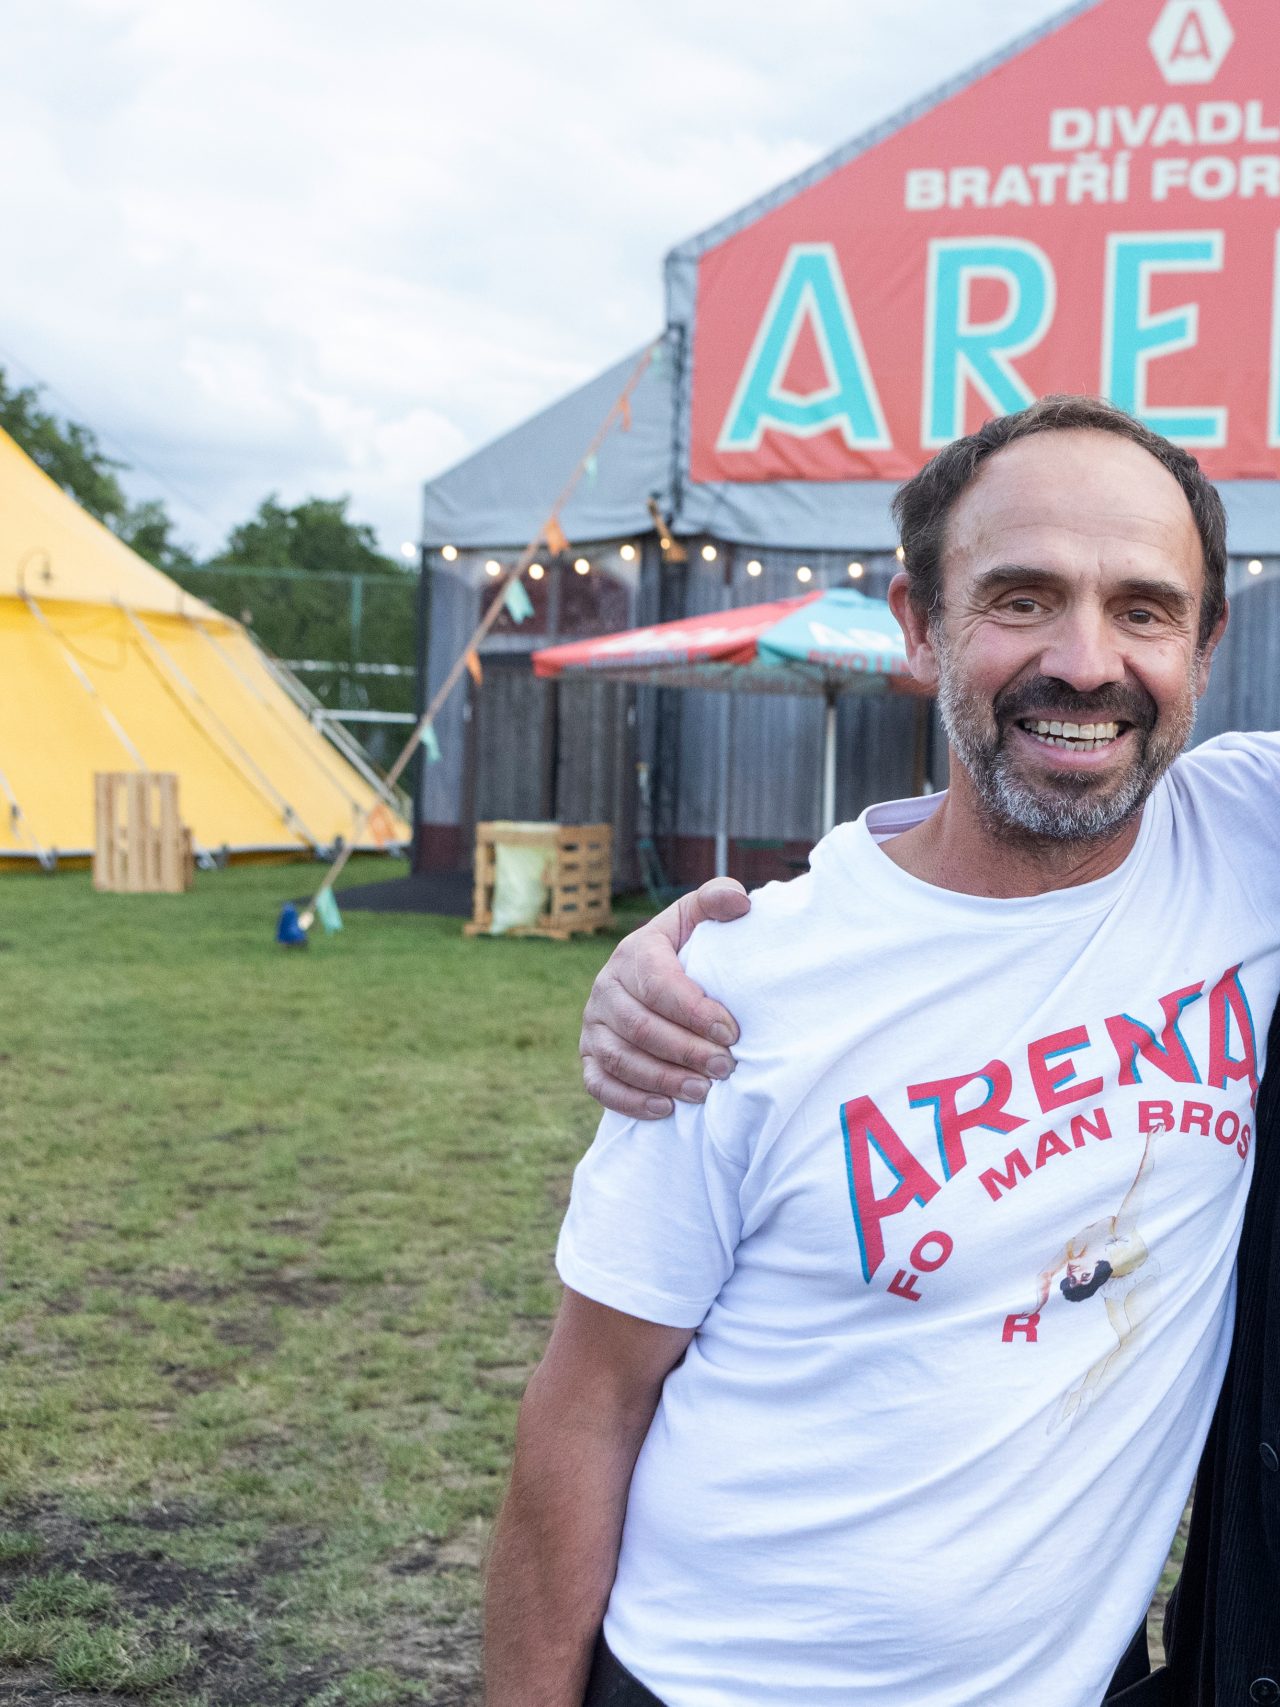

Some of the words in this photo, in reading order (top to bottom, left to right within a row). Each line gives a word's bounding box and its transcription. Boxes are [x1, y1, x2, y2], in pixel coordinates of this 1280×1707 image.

[1167, 8, 1212, 66] A
[904, 150, 1132, 211] BRATŘÍ
[839, 961, 1260, 1285] ARENA
[886, 1229, 955, 1303] FO
[977, 1106, 1113, 1202] MAN
[1137, 1099, 1252, 1161] BROS
[1000, 1313, 1040, 1344] R
